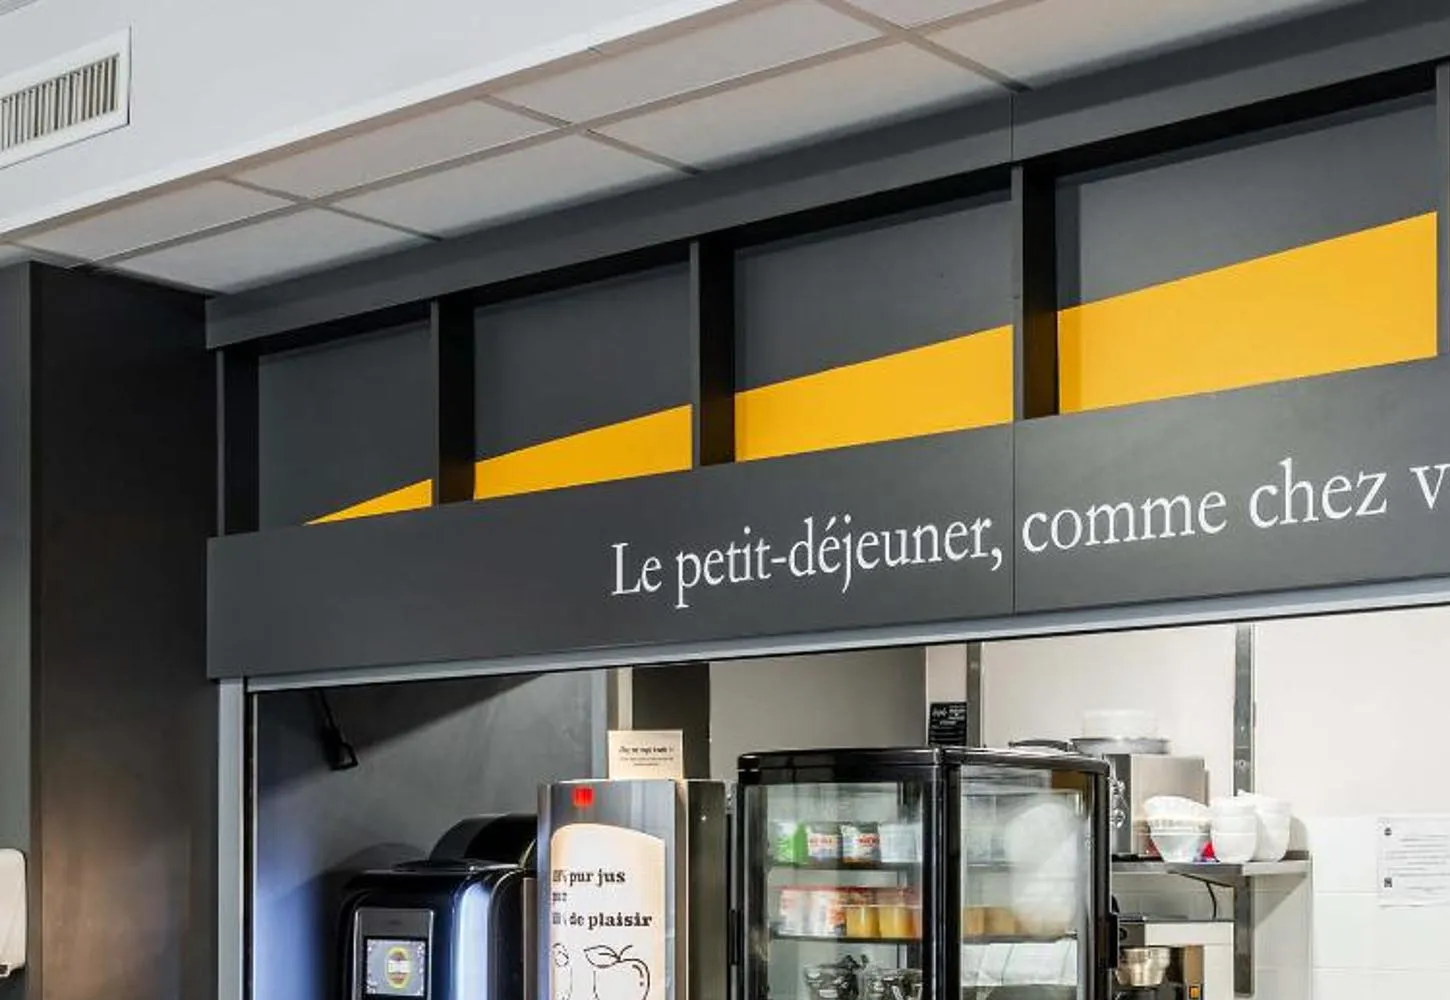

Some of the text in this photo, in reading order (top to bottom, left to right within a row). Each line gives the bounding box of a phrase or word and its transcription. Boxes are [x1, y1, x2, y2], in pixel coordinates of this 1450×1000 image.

[609, 541, 663, 596] Le
[674, 513, 1004, 610] petit-déjeuner,
[1021, 488, 1229, 553] comme
[1248, 457, 1389, 530] chez
[569, 871, 594, 887] pur
[596, 868, 626, 887] jus
[587, 911, 653, 931] plaisir
